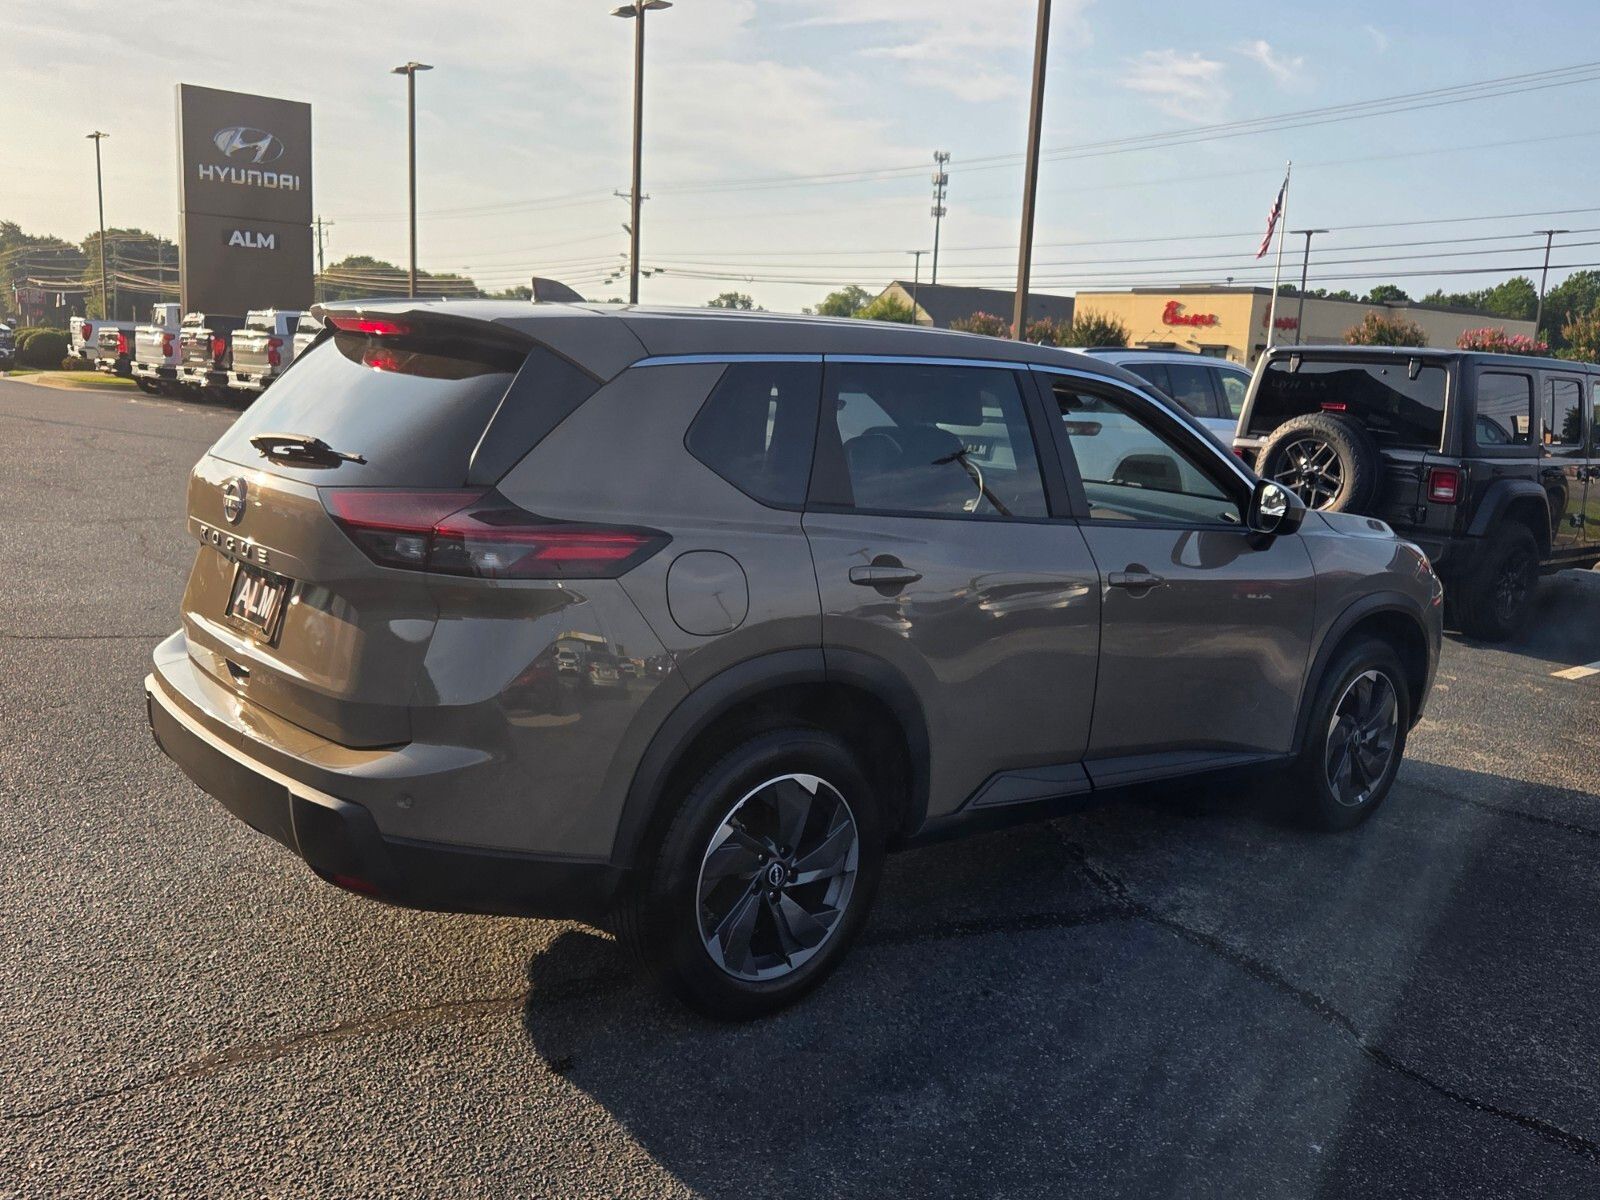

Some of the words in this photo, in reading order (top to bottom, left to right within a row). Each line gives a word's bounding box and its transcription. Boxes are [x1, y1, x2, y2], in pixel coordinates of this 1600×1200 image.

[198, 163, 300, 191] HYUNDAI
[228, 229, 275, 250] ALM
[965, 444, 987, 455] ALM
[200, 525, 268, 563] ROGUE
[234, 577, 276, 620] ALM
